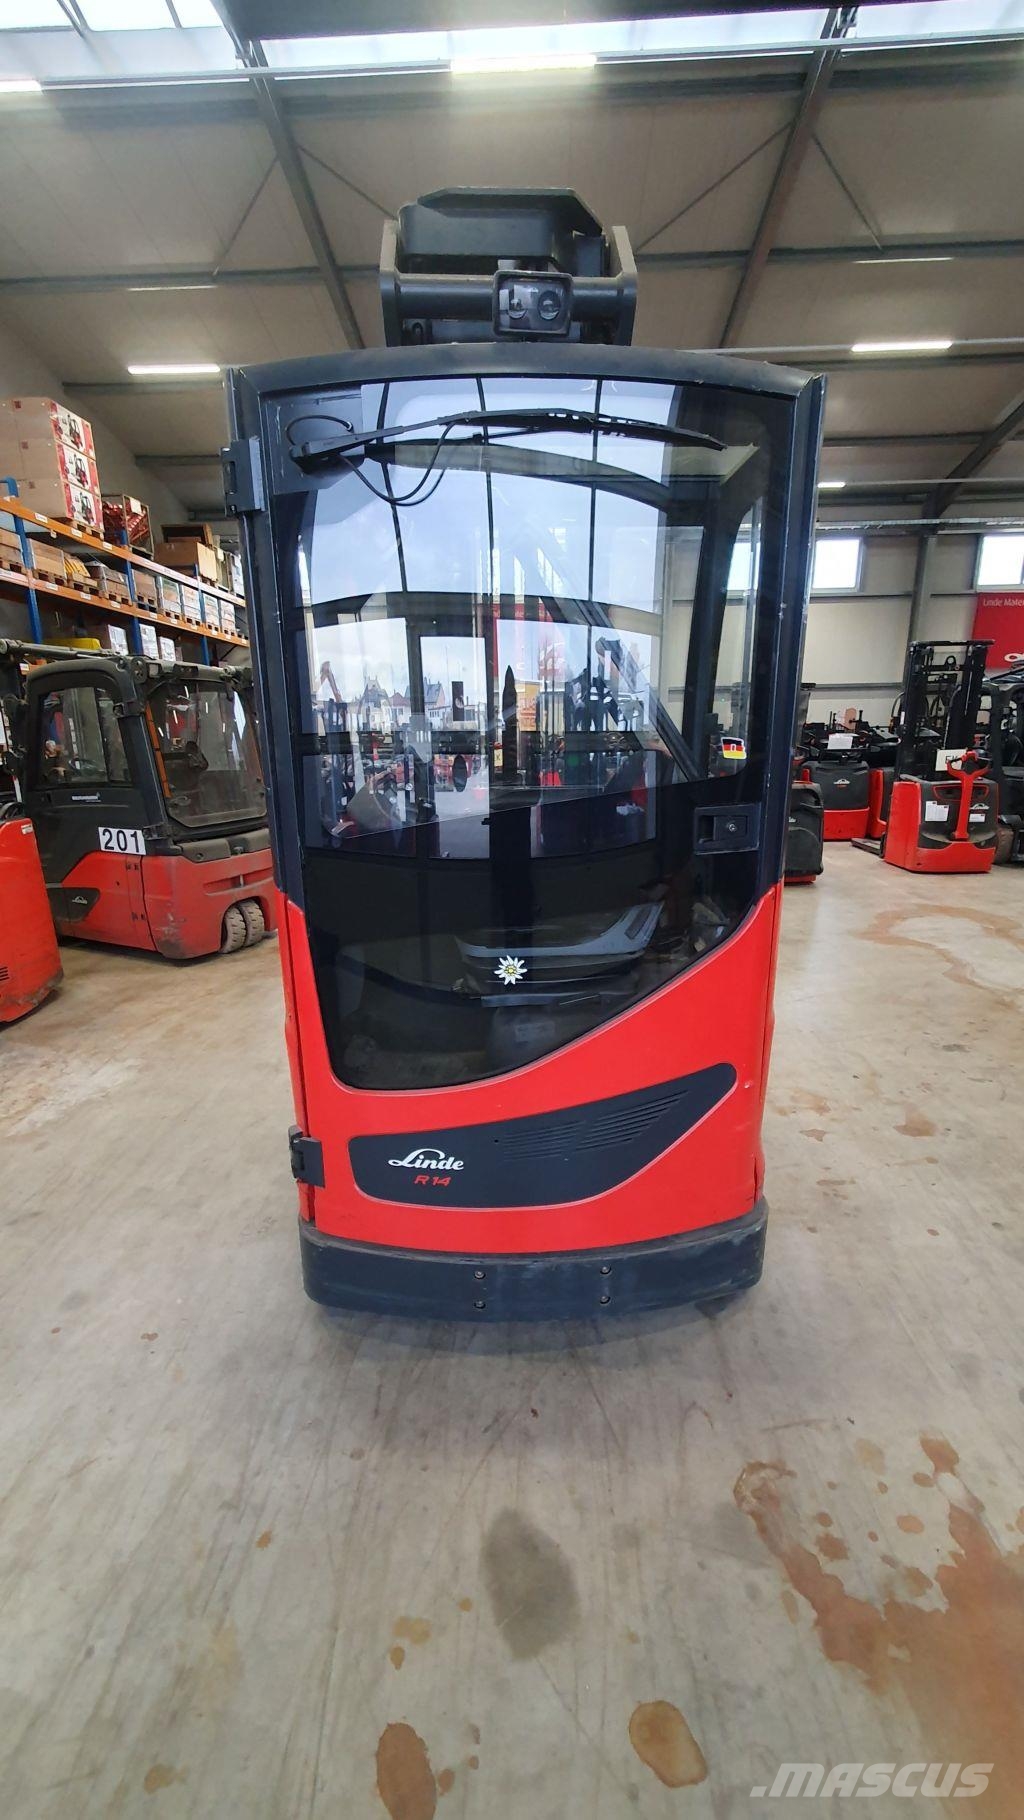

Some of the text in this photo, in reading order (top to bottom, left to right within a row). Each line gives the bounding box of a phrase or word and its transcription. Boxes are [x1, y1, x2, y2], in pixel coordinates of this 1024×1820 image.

[983, 598, 1003, 607] Linde
[102, 828, 140, 853] 201
[388, 1148, 464, 1170] Linde
